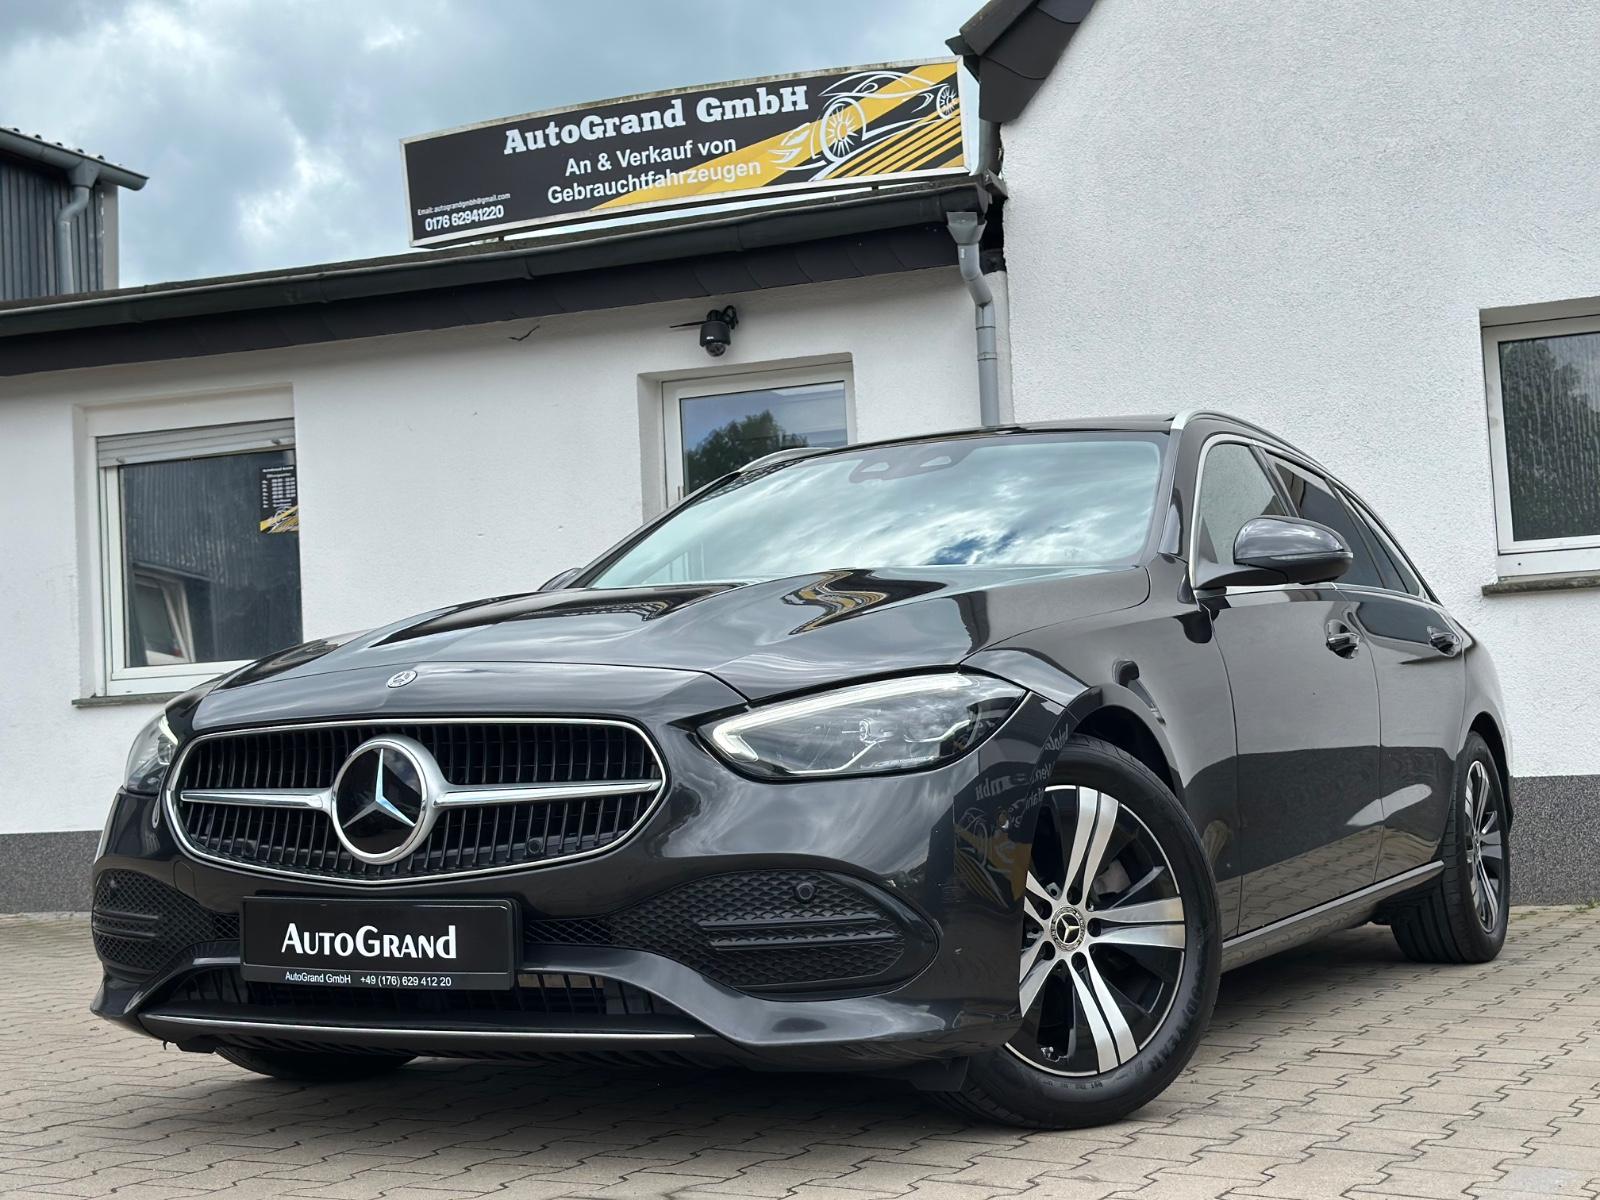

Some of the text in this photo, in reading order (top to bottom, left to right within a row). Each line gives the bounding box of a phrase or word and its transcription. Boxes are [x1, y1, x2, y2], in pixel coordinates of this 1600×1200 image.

[503, 85, 809, 155] AutoGrand GmbH
[565, 137, 736, 177] An & Verkauf von
[547, 160, 761, 204] Gebrauchtfahrzeugen
[425, 205, 504, 232] 0176 62941220
[285, 970, 452, 988] AutoGrand GmbH +49 (176) 629 412 20
